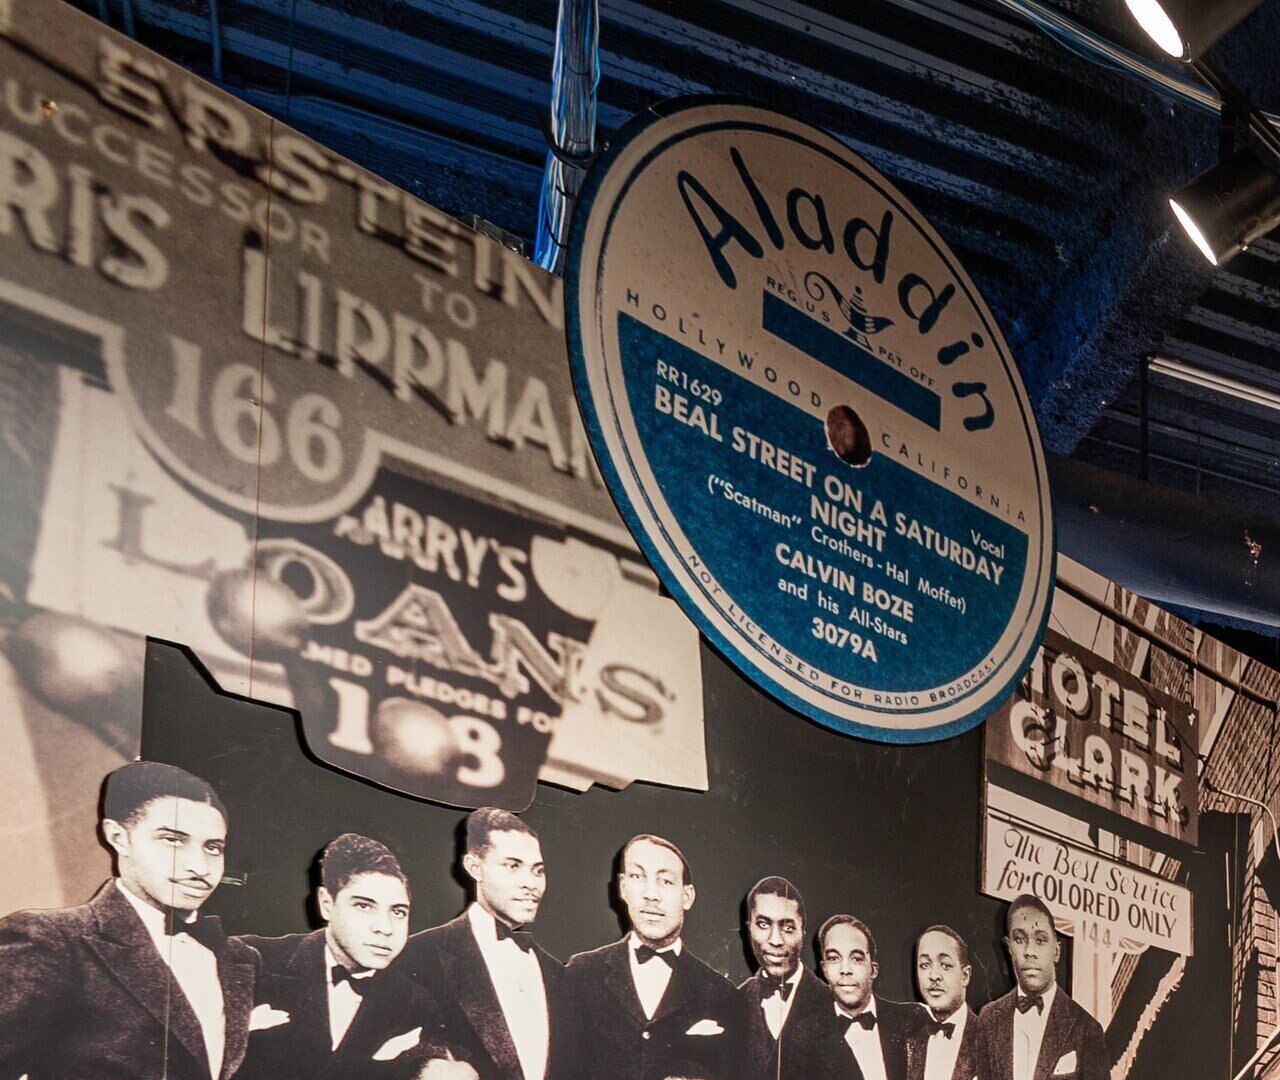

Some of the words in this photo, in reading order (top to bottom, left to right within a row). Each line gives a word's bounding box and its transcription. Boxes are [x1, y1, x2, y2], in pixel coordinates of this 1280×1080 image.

[101, 38, 563, 330] EPSTEIN
[413, 273, 478, 331] TO
[677, 147, 996, 432] Aladdin
[162, 332, 343, 483] 166
[625, 288, 822, 408] HOLLYWOOD
[880, 432, 1027, 524] CALIFORNIA
[656, 359, 724, 407] RR1629
[654, 384, 724, 443] BEAL
[731, 424, 818, 490] STREET
[824, 474, 864, 514] ON
[870, 499, 888, 527] A
[895, 512, 1004, 586] SATURDAY
[810, 494, 887, 552] NIGHT
[970, 528, 1005, 561] Vocal
[774, 541, 856, 598] CALVIN
[862, 581, 915, 625] BOZE
[777, 577, 809, 601] and
[817, 590, 841, 616] his
[848, 607, 909, 646] All-Stars
[811, 526, 874, 570] Crothers
[885, 560, 910, 586] Hal
[917, 576, 967, 616] Moffet)
[686, 553, 723, 598] NOT
[726, 603, 821, 682] LICENSED
[830, 679, 865, 700] FOR
[874, 690, 921, 708] RADIO
[929, 656, 1000, 704] BROADCAST
[811, 616, 879, 664] 3079A
[998, 860, 1032, 894] for
[1030, 871, 1122, 924] COLORED
[1127, 902, 1179, 941] ONLY
[1003, 827, 1045, 866] The
[1052, 843, 1099, 885] Best
[1105, 864, 1180, 912] Service
[1081, 919, 1113, 950] 144
